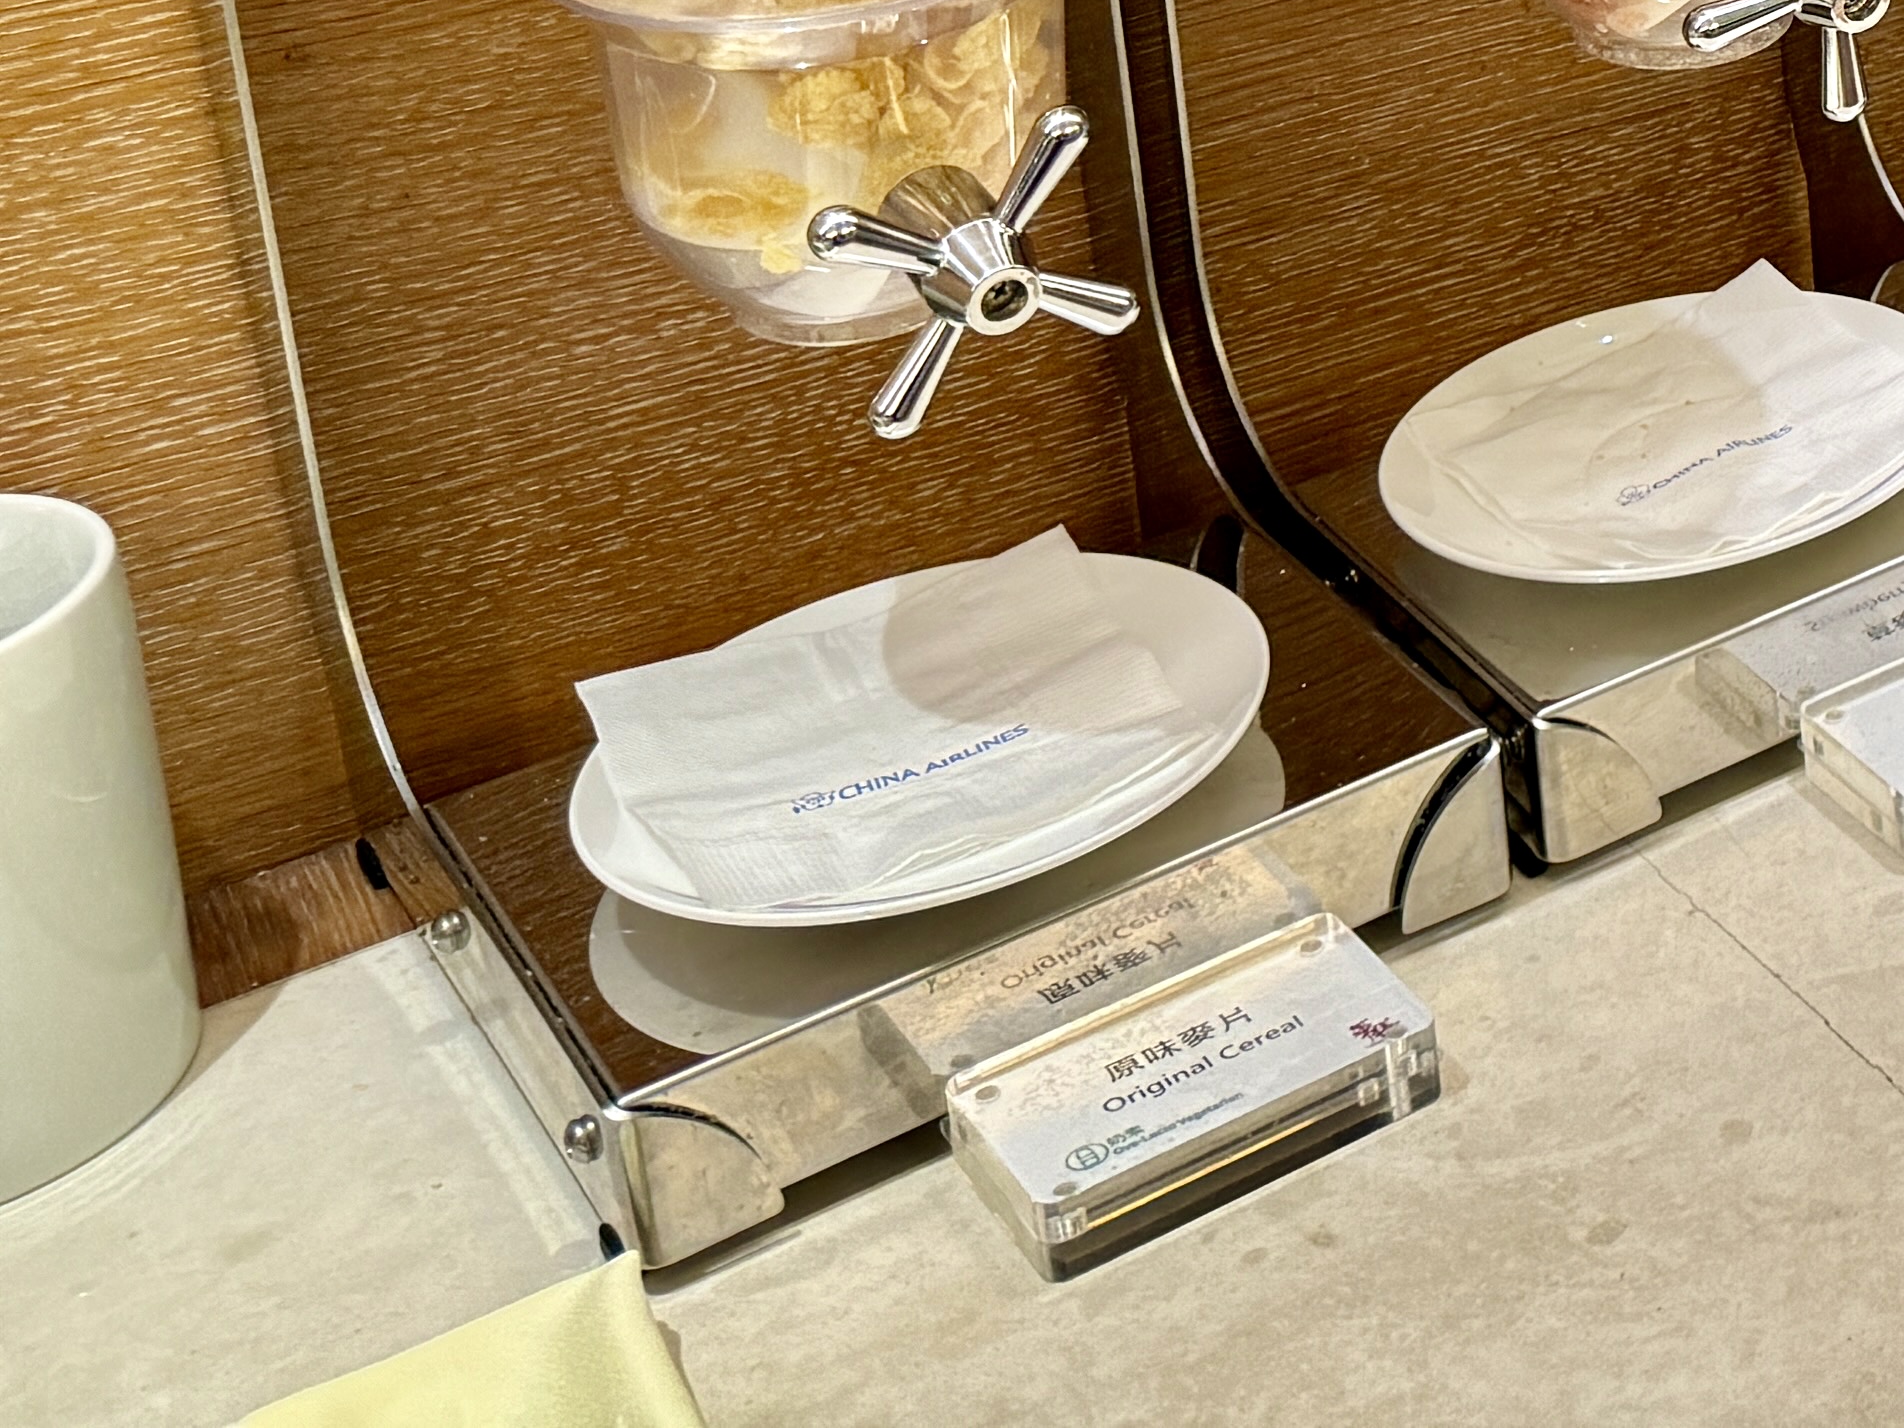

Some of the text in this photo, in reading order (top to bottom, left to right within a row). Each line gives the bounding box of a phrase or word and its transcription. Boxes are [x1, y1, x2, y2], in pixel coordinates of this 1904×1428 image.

[1652, 423, 1793, 490] CHINA AIRLINES
[838, 722, 1030, 801] CHINA AIRLINES
[1102, 1055, 1214, 1114] Original
[1219, 1015, 1305, 1060] Cereal
[1103, 1006, 1253, 1083] 原味麥片
